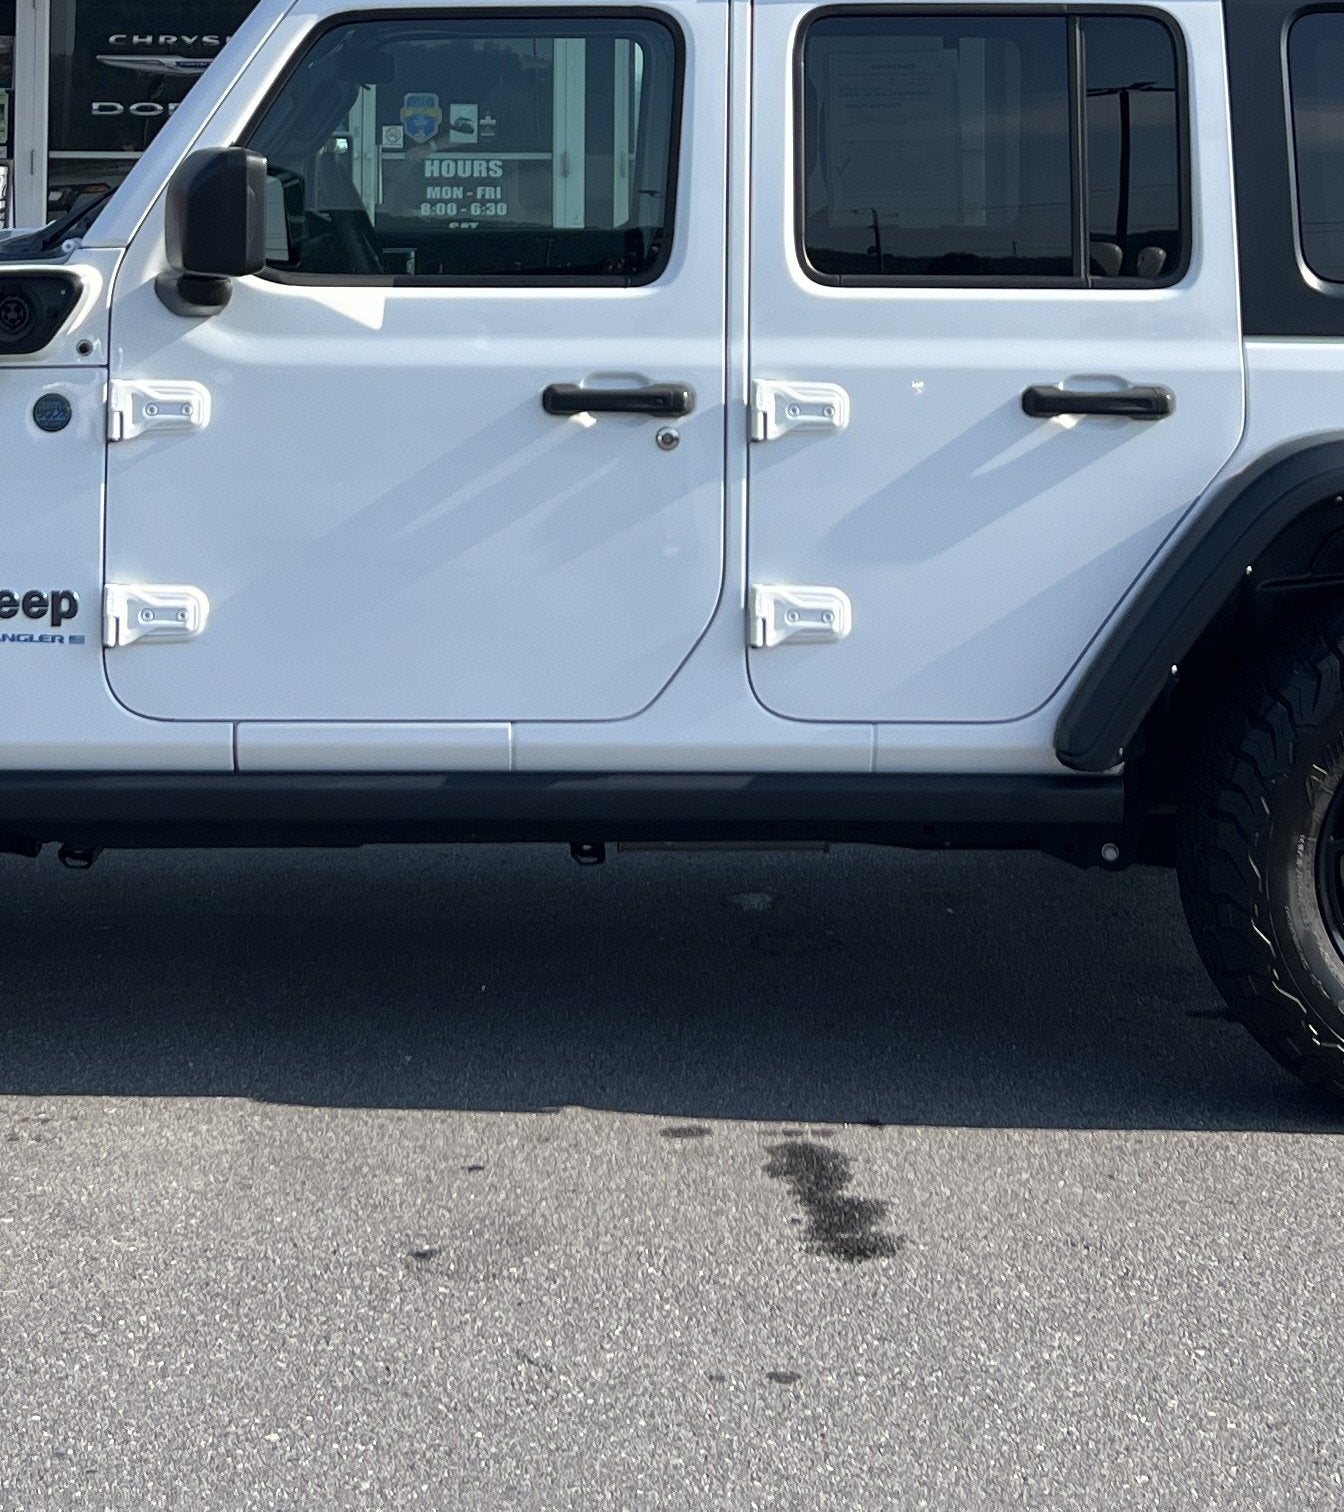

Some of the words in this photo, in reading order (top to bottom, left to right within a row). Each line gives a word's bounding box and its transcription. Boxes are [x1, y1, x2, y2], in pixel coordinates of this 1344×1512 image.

[424, 160, 503, 178] HOURS
[426, 186, 464, 200] MON
[476, 186, 502, 200] FRI
